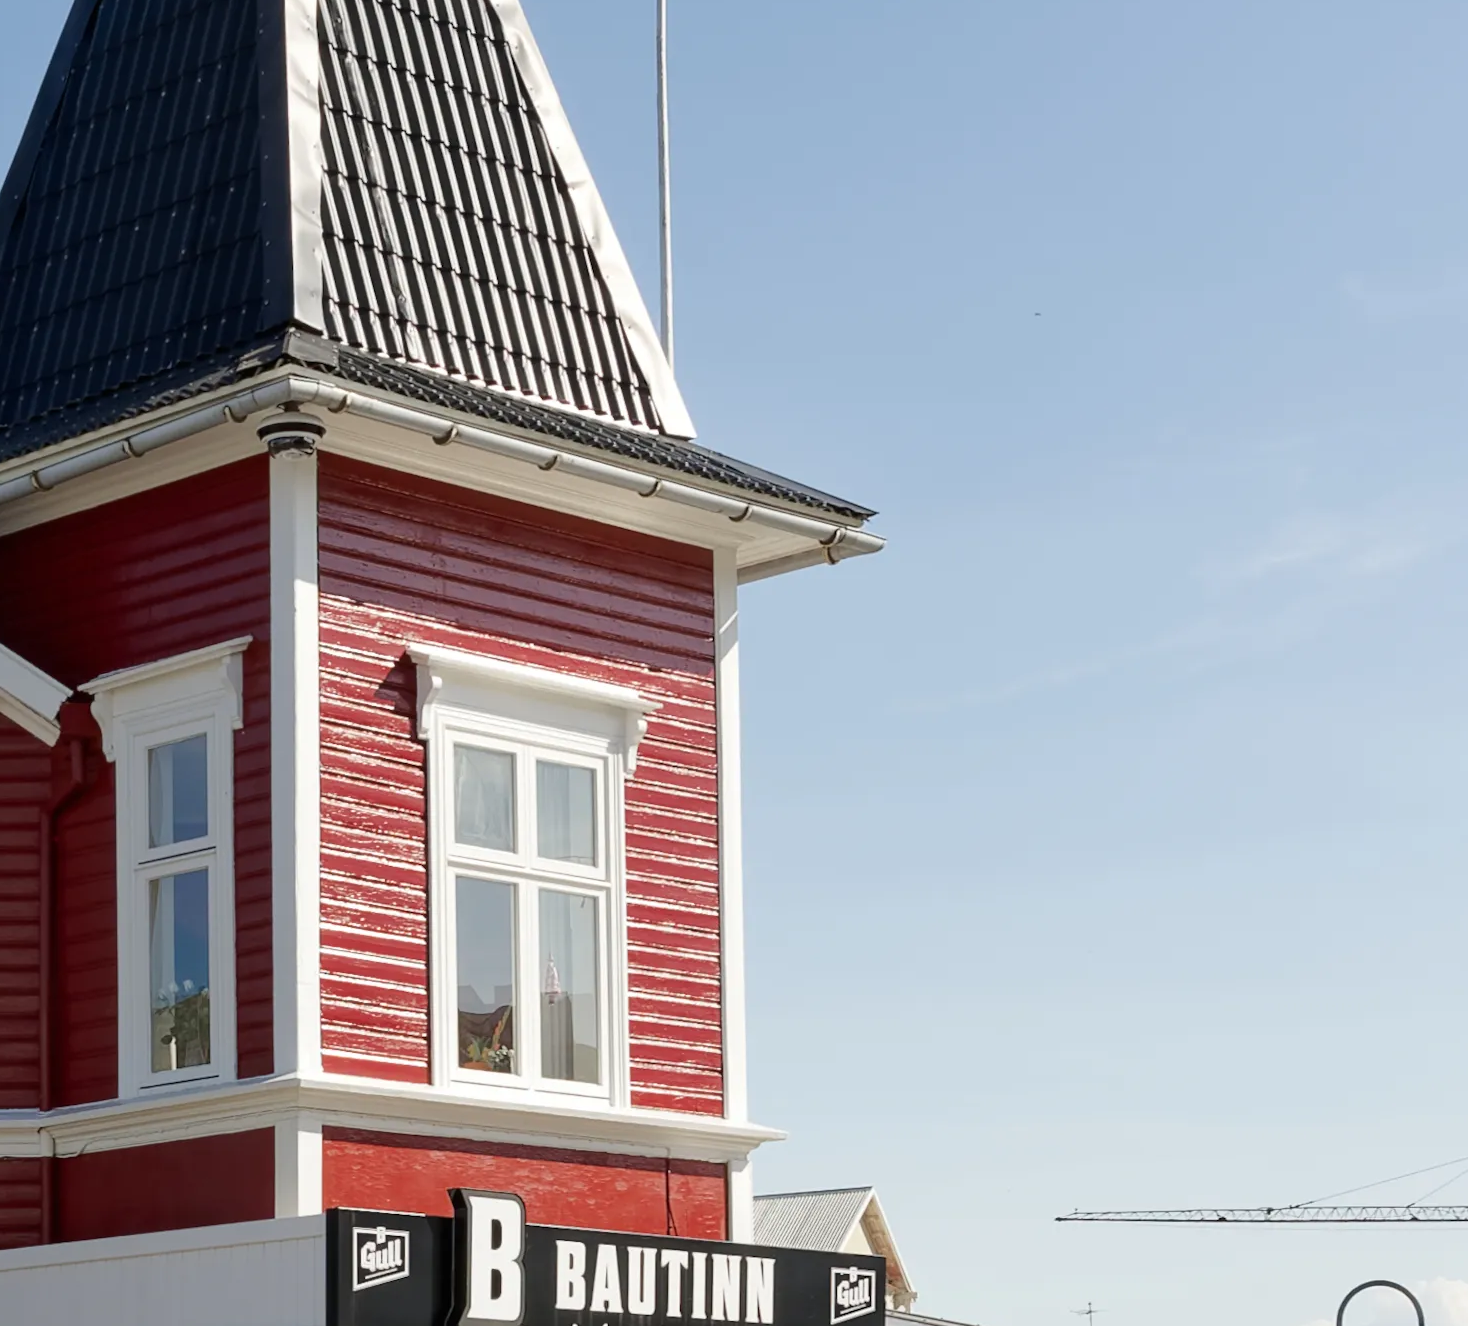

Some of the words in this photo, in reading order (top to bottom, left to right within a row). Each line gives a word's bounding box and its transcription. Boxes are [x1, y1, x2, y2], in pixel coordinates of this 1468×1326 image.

[360, 1238, 403, 1272] Gull
[466, 1195, 522, 1322] B
[555, 1240, 776, 1325] BAUTINN
[836, 1277, 870, 1308] Gull
